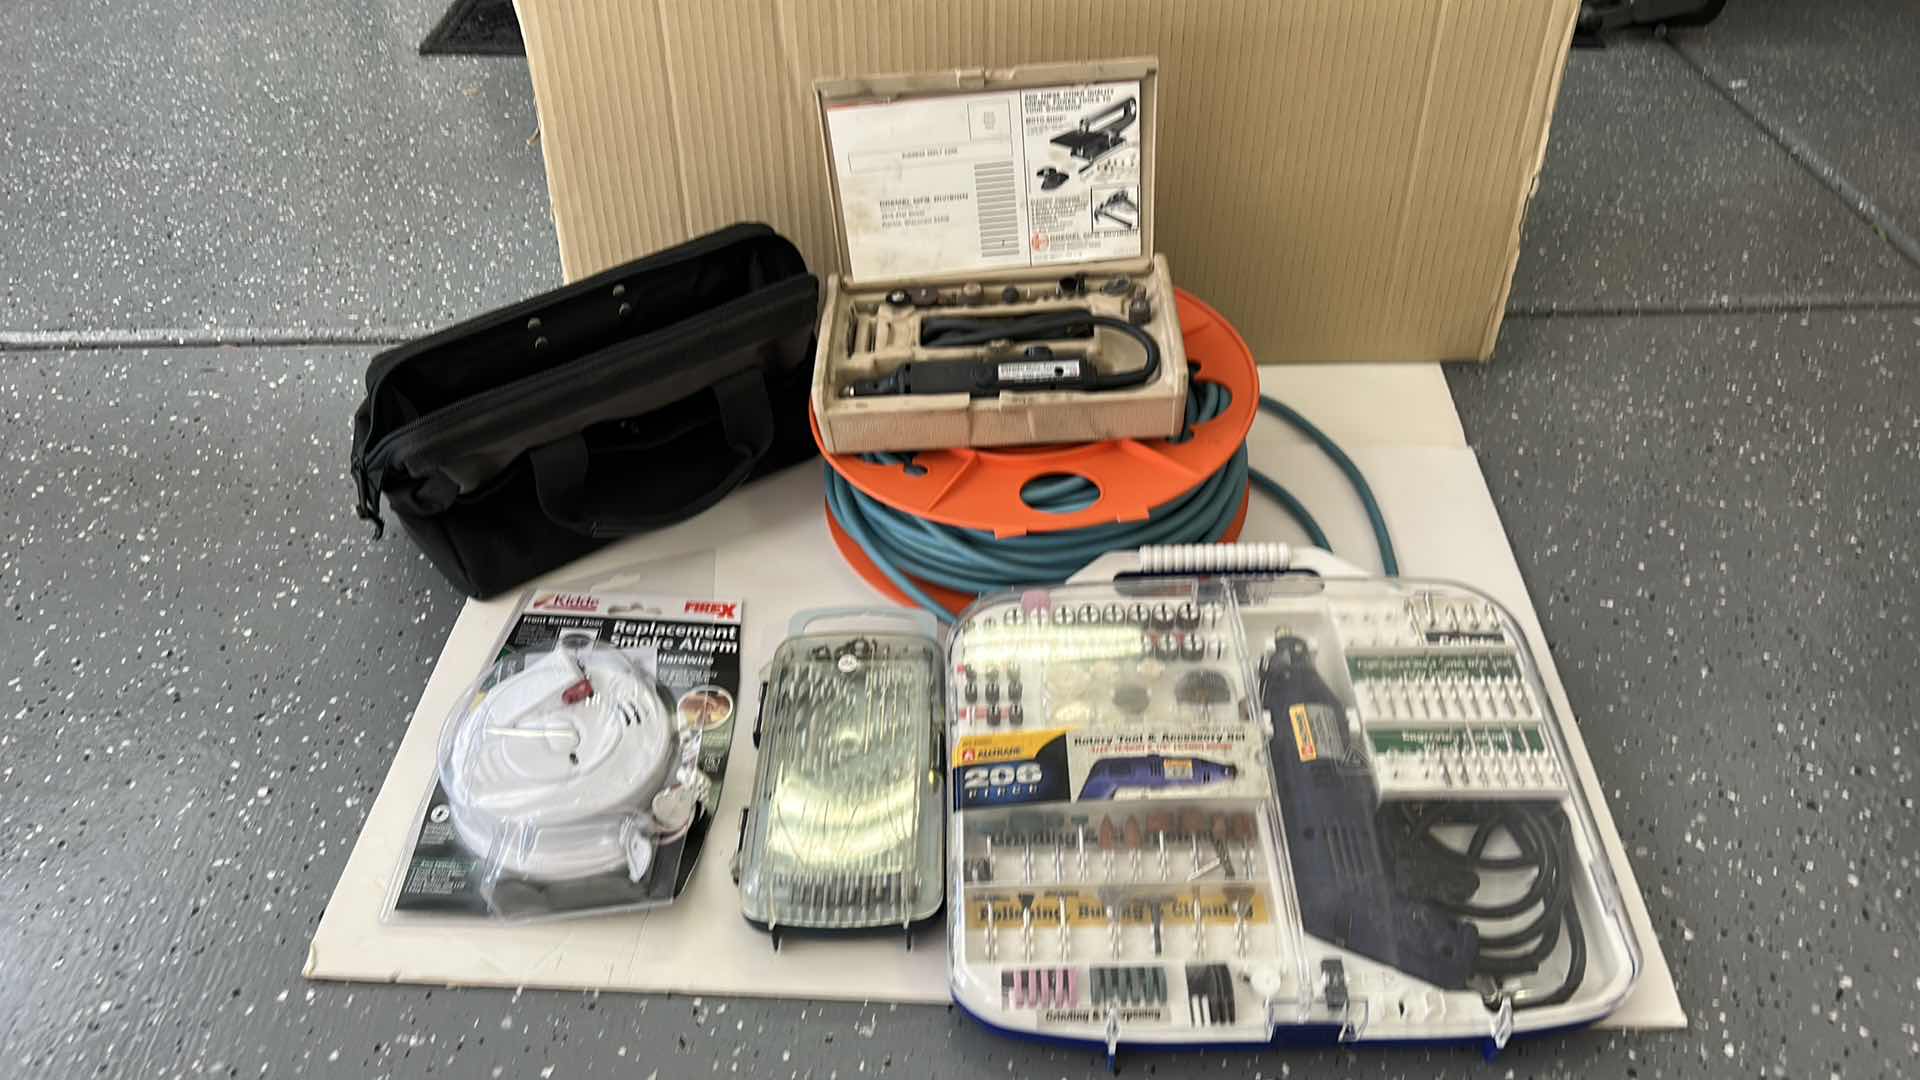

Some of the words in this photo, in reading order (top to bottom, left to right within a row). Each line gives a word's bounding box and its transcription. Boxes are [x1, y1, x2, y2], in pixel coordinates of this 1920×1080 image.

[613, 620, 738, 640] Replacement
[610, 634, 674, 650] Smoke
[684, 638, 738, 653] Alarm
